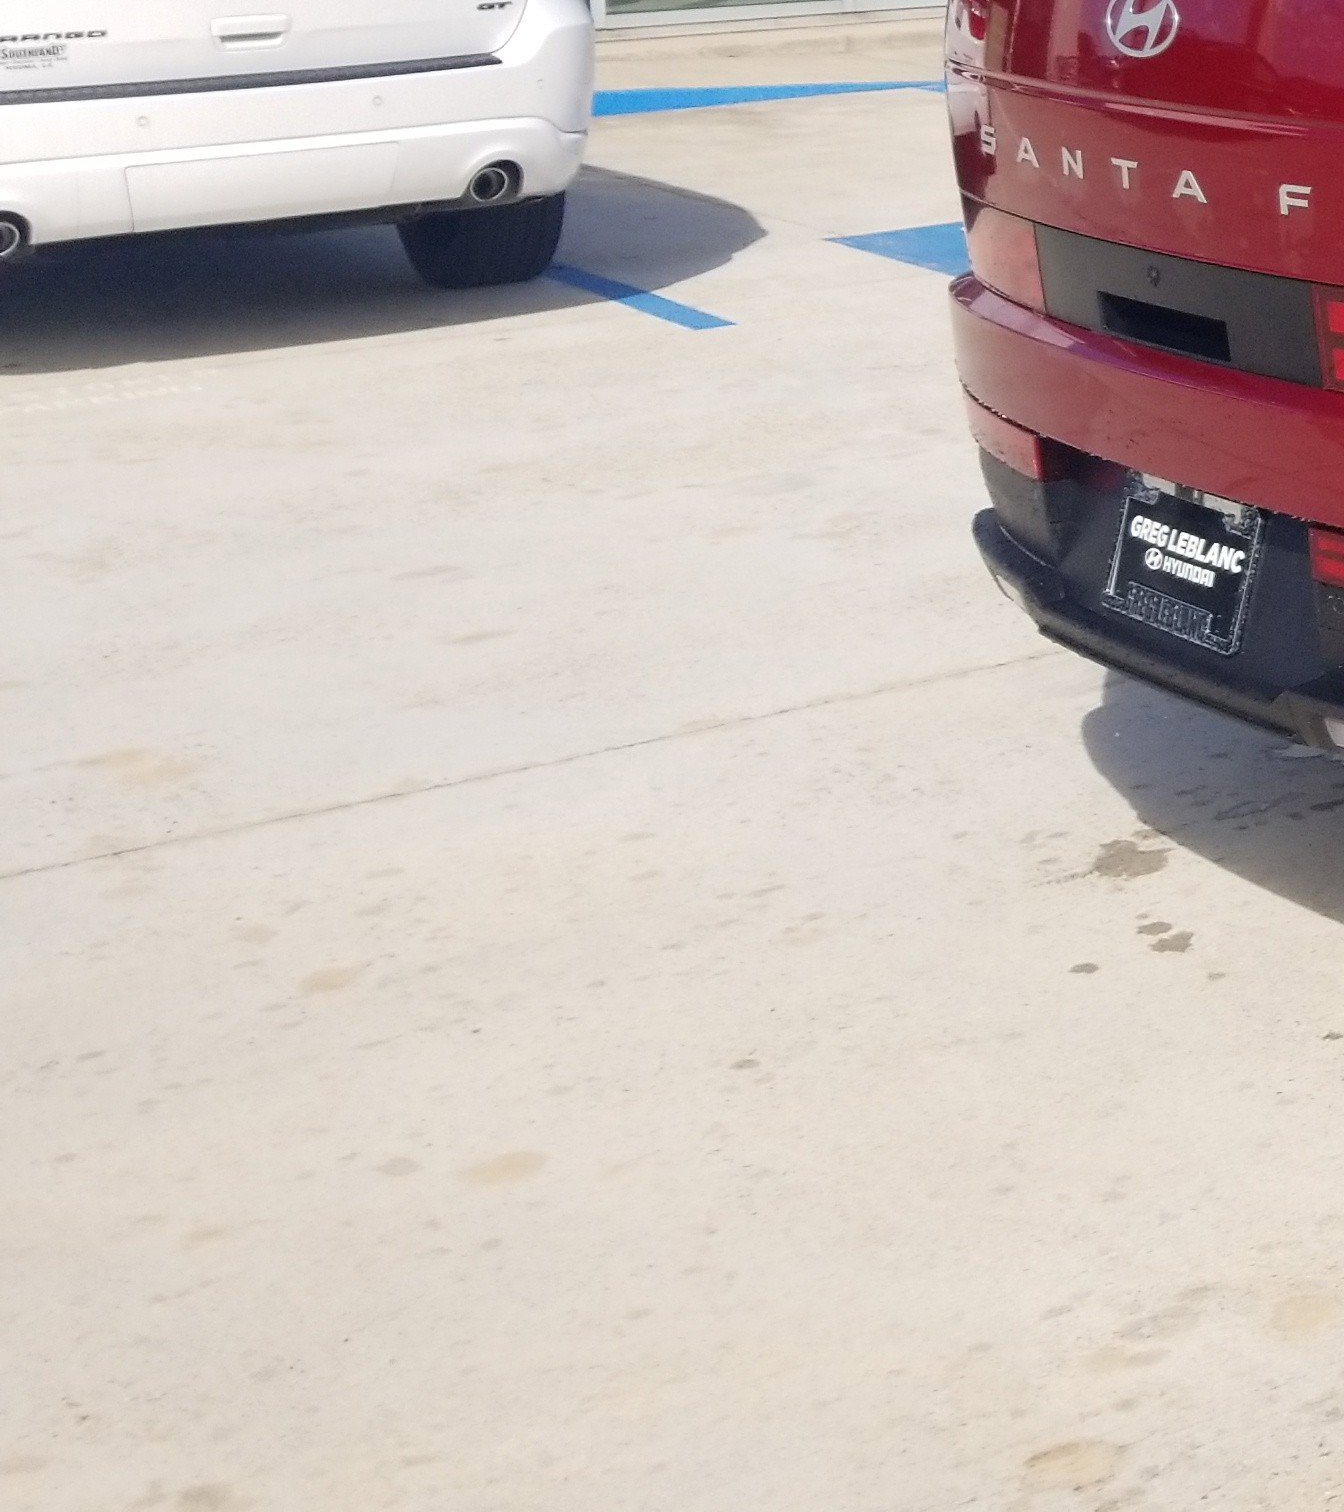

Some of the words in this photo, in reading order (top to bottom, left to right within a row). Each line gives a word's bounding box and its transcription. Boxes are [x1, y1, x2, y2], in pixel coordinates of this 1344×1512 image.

[476, 0, 513, 10] GT
[980, 124, 1208, 204] SANTA
[1130, 514, 1171, 548] GREG
[1166, 528, 1246, 574] LEBLANC
[1161, 555, 1217, 588] HYUNDAI
